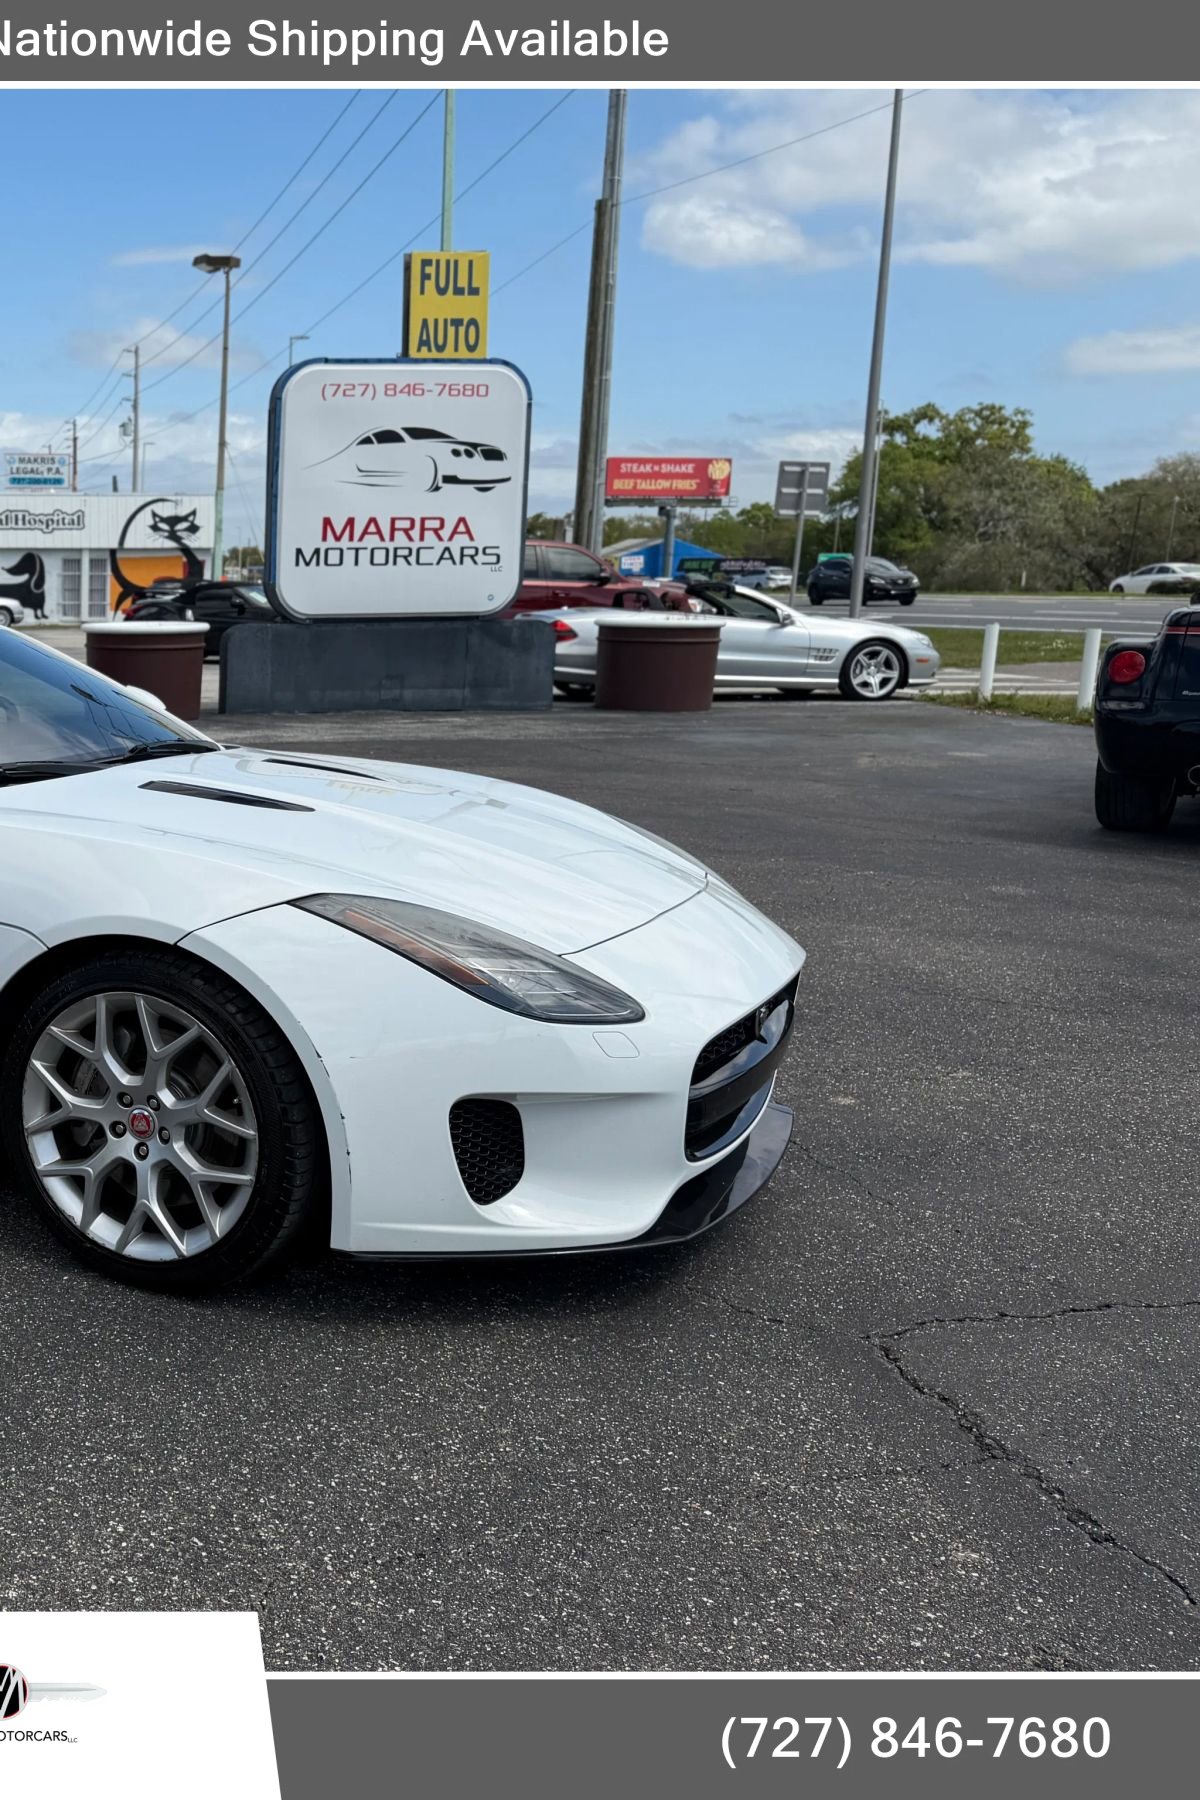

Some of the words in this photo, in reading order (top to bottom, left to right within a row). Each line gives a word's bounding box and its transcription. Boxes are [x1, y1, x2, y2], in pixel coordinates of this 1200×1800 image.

[419, 258, 481, 297] FULL
[416, 317, 481, 354] AUTO
[320, 382, 377, 401] (727)
[383, 383, 490, 398] 846-7680
[18, 456, 56, 465] MAKRIS
[620, 463, 652, 473] STEAK
[661, 463, 695, 473] SHAKE
[613, 479, 636, 490] BEEF
[636, 479, 671, 490] TALLOW
[13, 511, 83, 531] Hospital
[321, 516, 475, 543] MARRA
[295, 546, 501, 567] MOTORCARS
